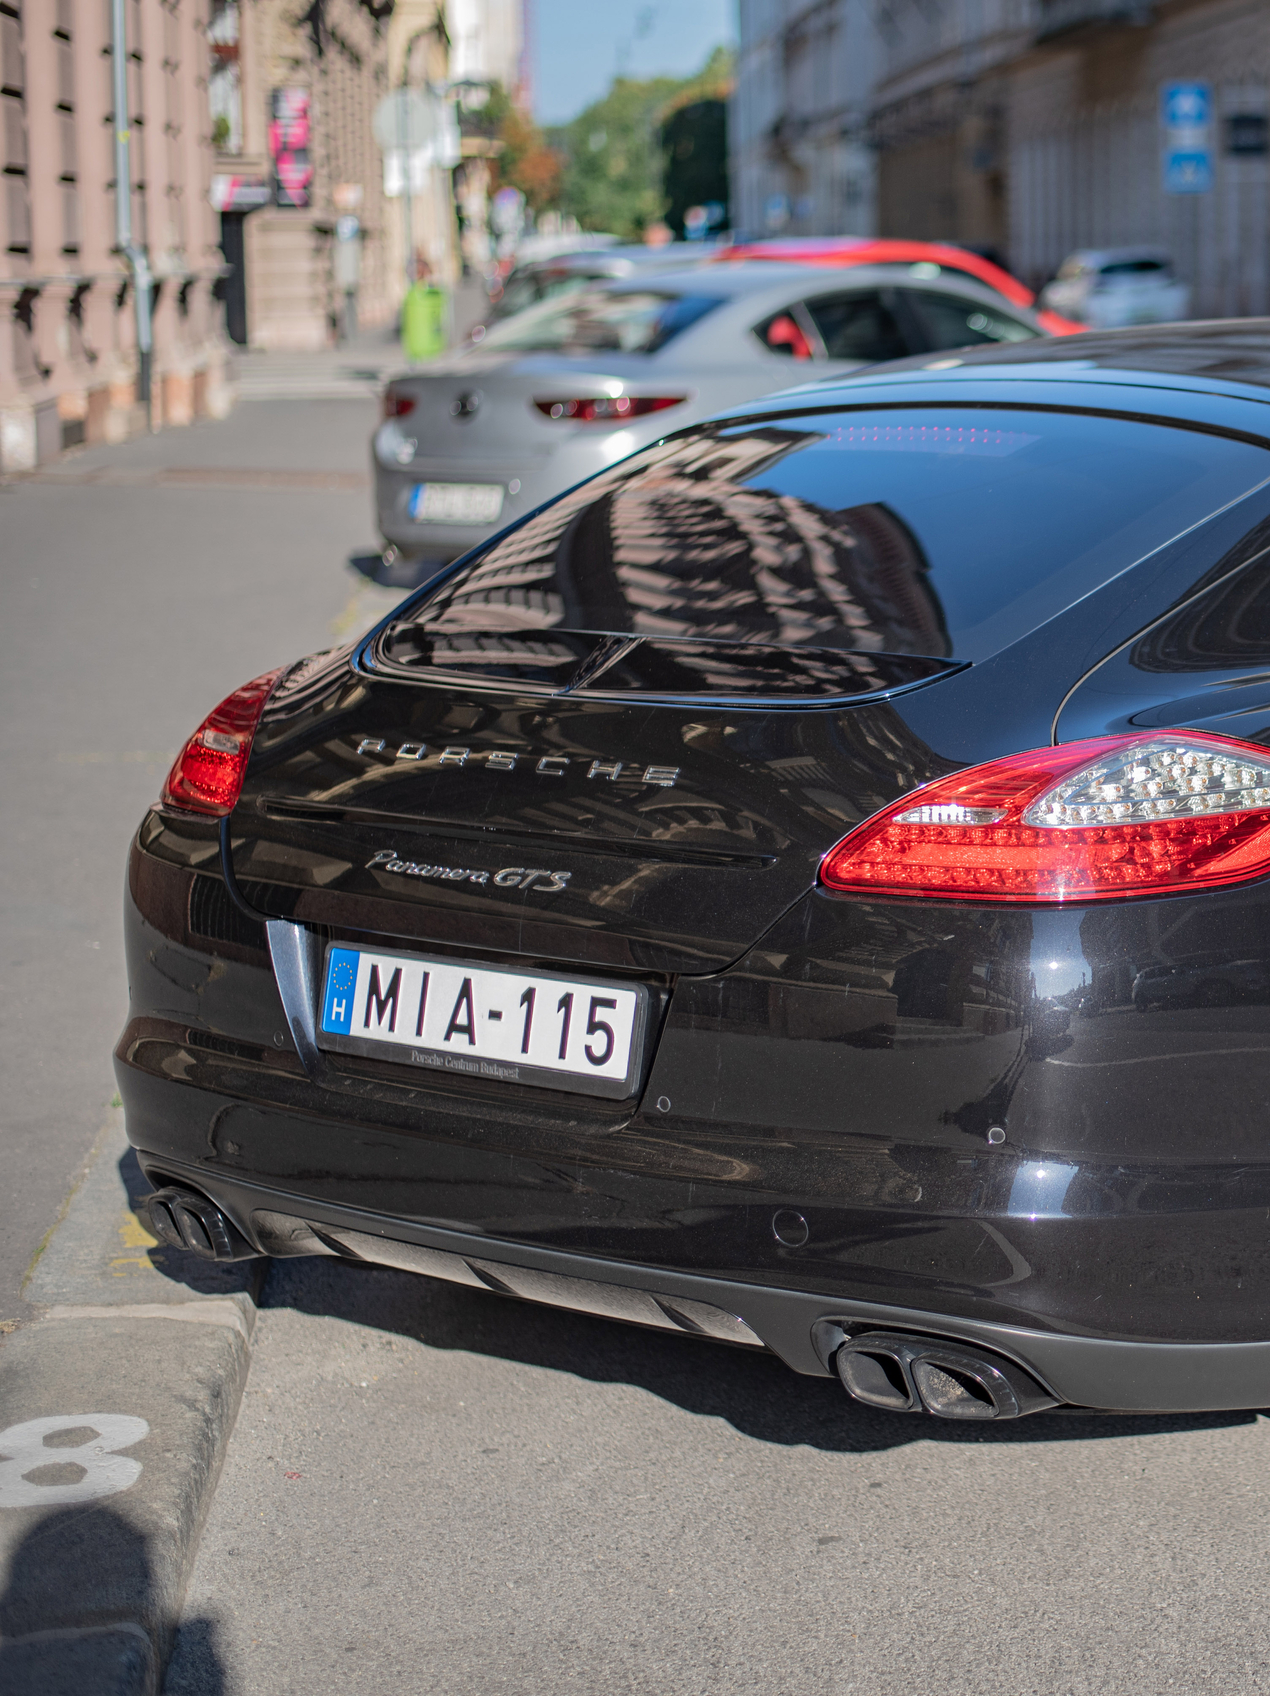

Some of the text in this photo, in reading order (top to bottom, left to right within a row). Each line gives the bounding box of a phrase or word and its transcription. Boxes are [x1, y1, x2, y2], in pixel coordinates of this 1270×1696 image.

[357, 738, 681, 787] PORSCHE
[365, 850, 572, 892] Panamera GTS
[331, 996, 347, 1022] H
[363, 963, 618, 1067] MIA-115
[411, 1050, 519, 1079] Porsche Centrum Budapest
[0, 1413, 149, 1507] 8
